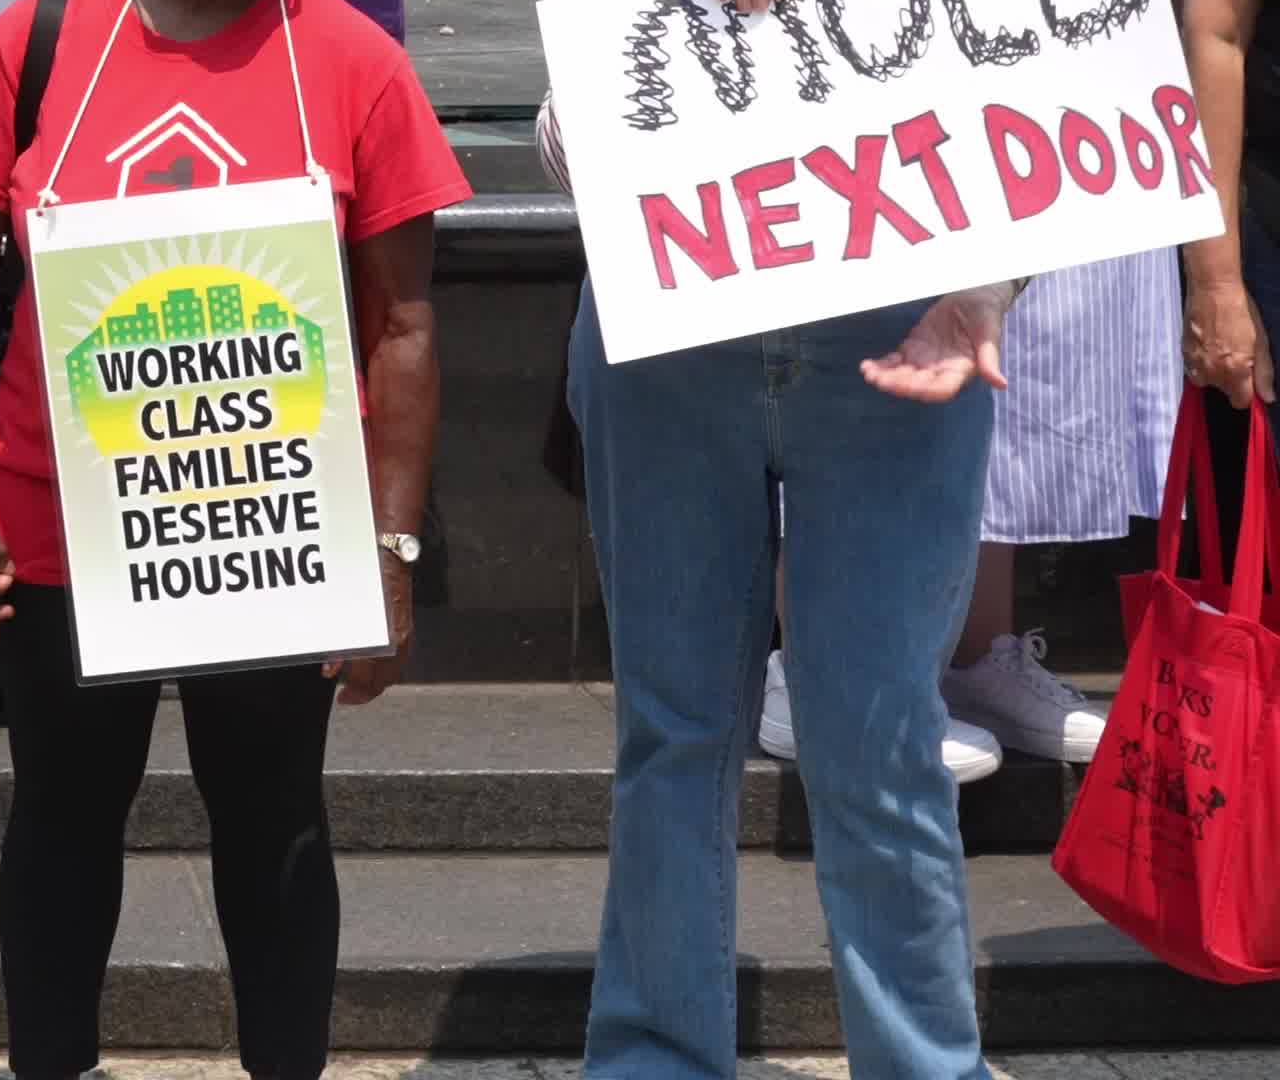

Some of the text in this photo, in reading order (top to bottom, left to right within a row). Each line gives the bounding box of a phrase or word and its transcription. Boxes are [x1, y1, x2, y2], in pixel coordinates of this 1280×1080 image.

[637, 85, 1216, 289] NEXT DOOR
[97, 332, 302, 392] WORKING
[141, 389, 272, 440] CLASS
[114, 438, 313, 497] FAMILIES
[122, 490, 320, 549] DESERVE
[129, 544, 326, 602] HOUSING
